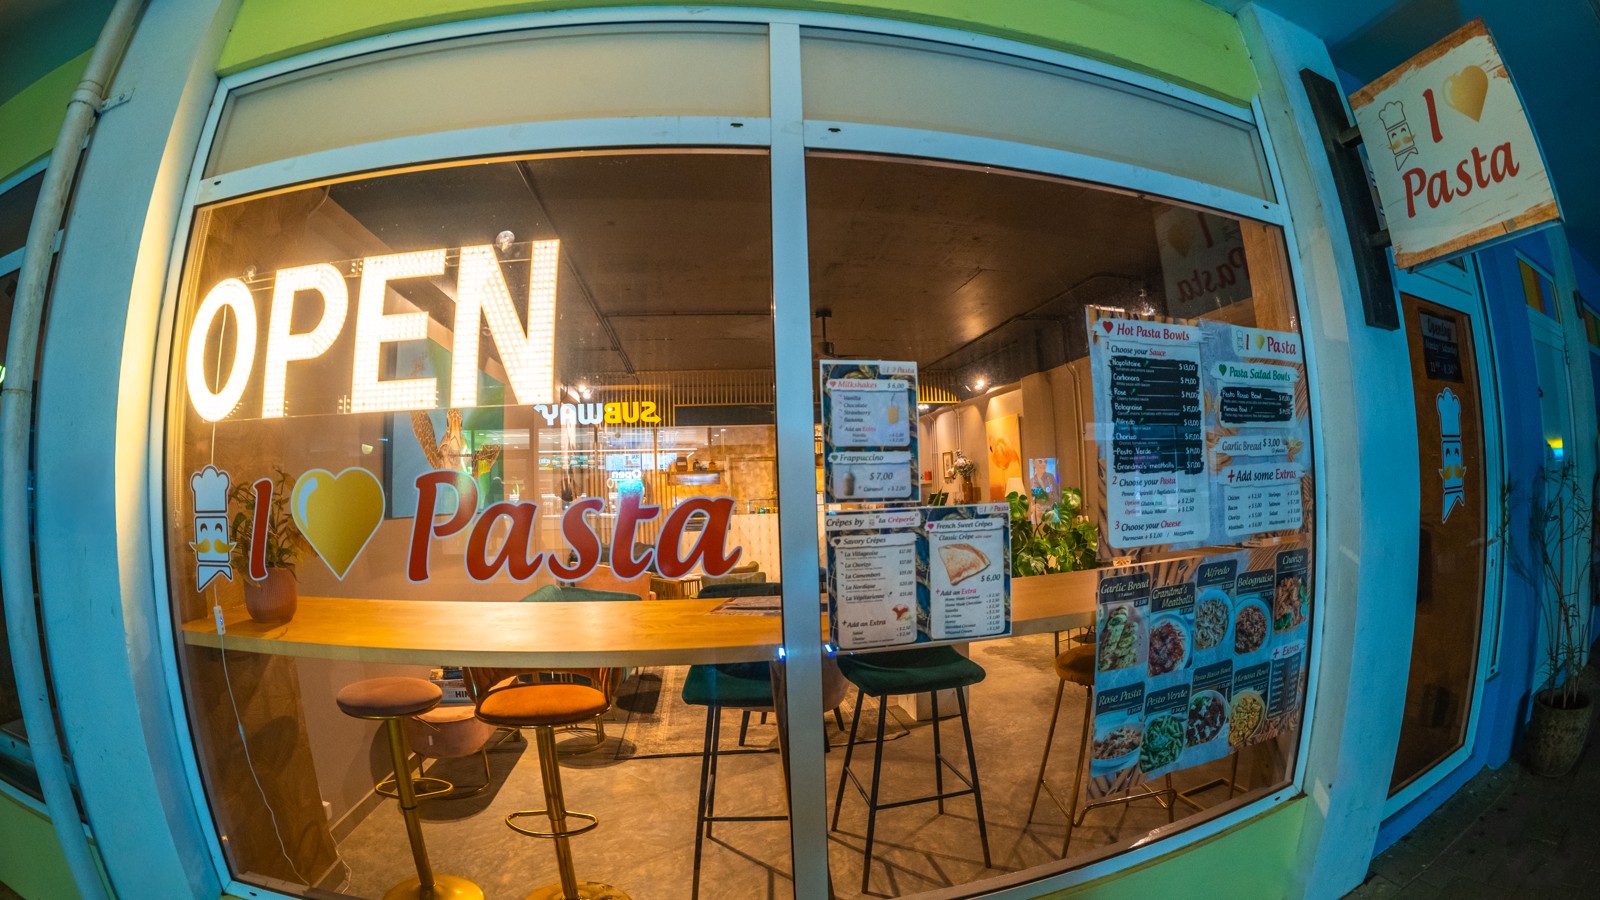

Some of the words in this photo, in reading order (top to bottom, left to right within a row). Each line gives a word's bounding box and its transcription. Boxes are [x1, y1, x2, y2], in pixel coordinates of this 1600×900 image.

[1422, 88, 1444, 144] I
[1401, 141, 1520, 219] Pasta
[185, 238, 561, 422] OPEN
[1117, 322, 1134, 336] Hot
[1136, 325, 1161, 339] Pasta
[1163, 328, 1190, 341] Bowls
[1111, 345, 1134, 354] Choose
[1134, 347, 1148, 355] your
[1149, 348, 1166, 356] Sauce
[1245, 333, 1249, 351] I
[1267, 336, 1296, 355] Pasta
[1229, 366, 1249, 378] Pasta
[1249, 368, 1272, 380] Salad
[1272, 370, 1291, 381] Bowls
[1222, 441, 1242, 452] Garlic
[1243, 441, 1262, 451] Bread
[1268, 438, 1280, 448] 3,00
[840, 453, 884, 463] Frappuccino
[876, 472, 894, 481] 7,00
[1112, 475, 1117, 485] 2
[1119, 478, 1142, 487] Choose
[1142, 479, 1159, 487] your
[1160, 477, 1176, 485] Pasta
[1236, 470, 1252, 482] Add
[1254, 471, 1274, 480] some
[1275, 468, 1297, 480] Extras
[249, 477, 273, 581] I
[406, 469, 743, 584] Pasta
[826, 518, 853, 527] Crêpes
[854, 518, 864, 527] by
[1115, 521, 1120, 530] 3
[1121, 523, 1144, 532] Choose
[1144, 524, 1160, 532] your
[1160, 520, 1182, 529] Cheese
[843, 538, 864, 546] Savory
[986, 573, 1001, 581] 6,00
[1203, 565, 1230, 578] Alfredo
[1100, 582, 1126, 594] Garlic
[1127, 579, 1150, 591] Bread
[1237, 573, 1274, 587] Bolognaise
[1152, 585, 1188, 600] Grandma's
[1161, 595, 1194, 609] Meatballs
[1119, 689, 1142, 702] Pasta
[1146, 696, 1166, 707] Pesto
[1167, 689, 1188, 701] Verde
